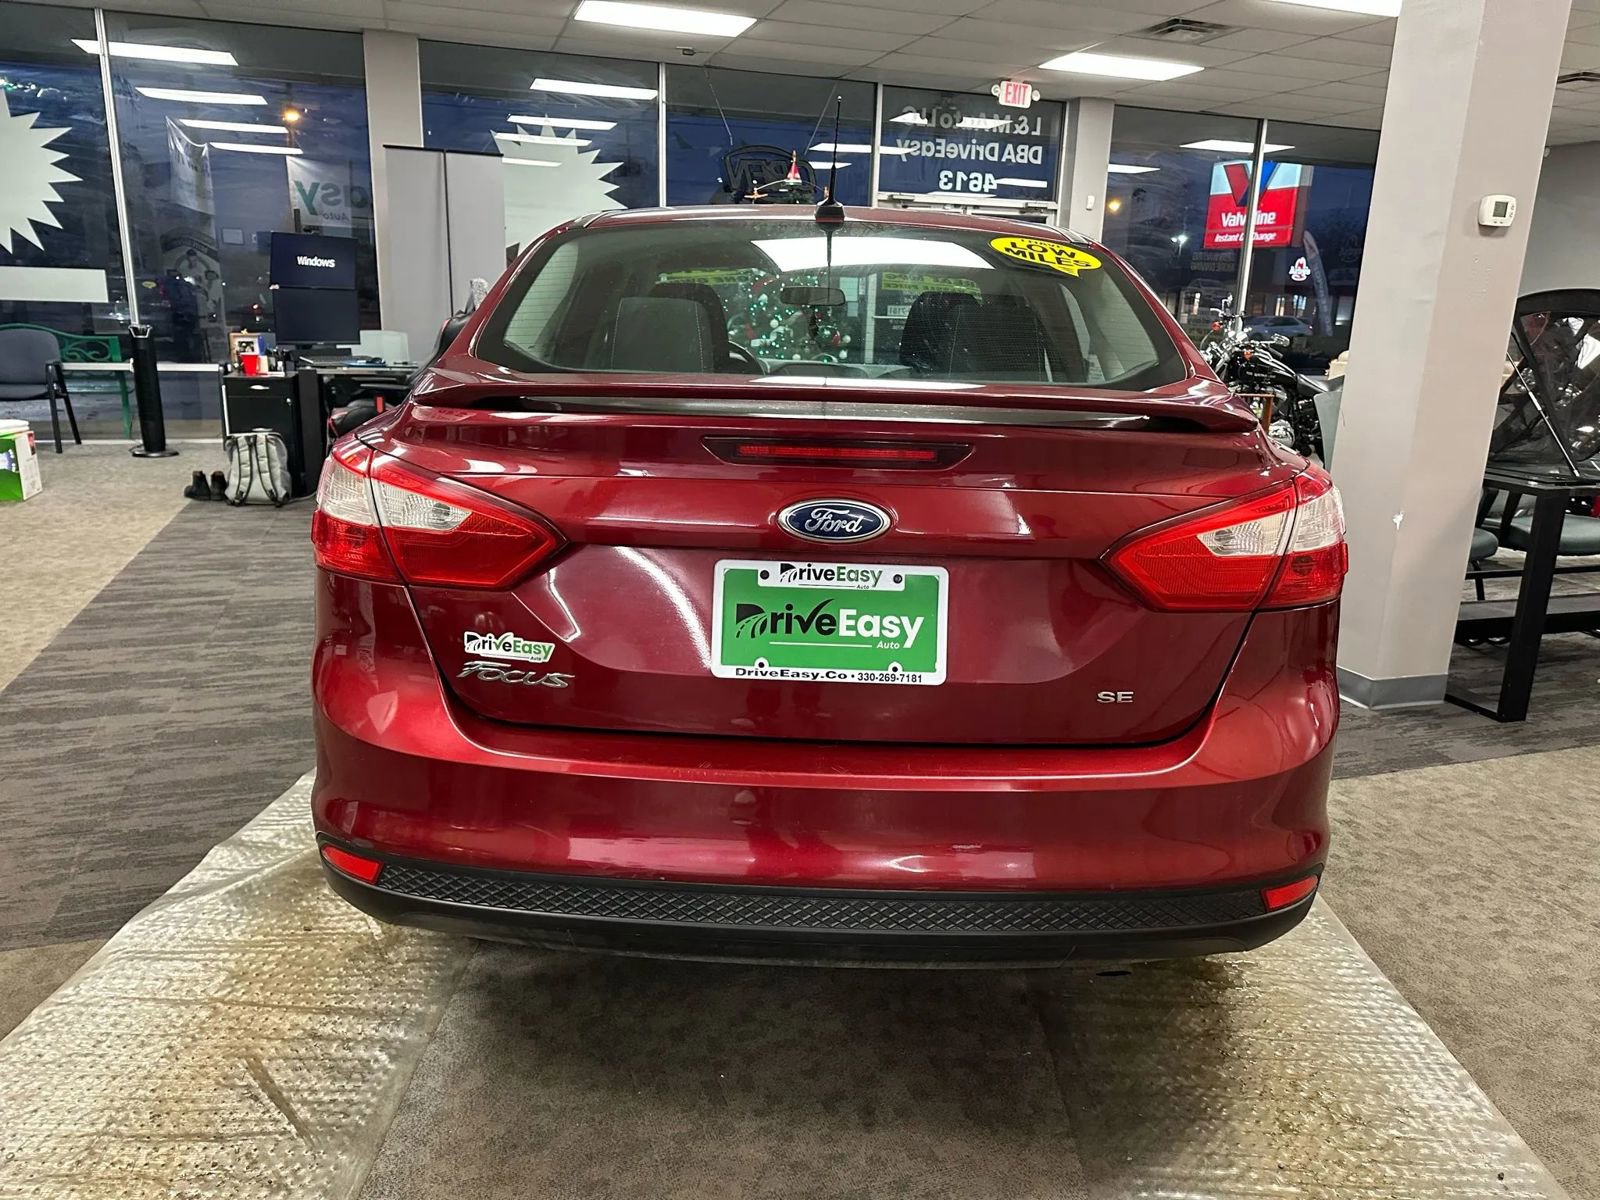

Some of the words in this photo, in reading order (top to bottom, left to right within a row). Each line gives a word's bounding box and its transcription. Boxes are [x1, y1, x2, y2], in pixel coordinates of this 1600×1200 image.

[1005, 82, 1028, 105] EXIT
[1221, 210, 1277, 228] Valvine
[1004, 247, 1092, 267] MILES
[1010, 241, 1076, 259] LOW
[297, 255, 336, 268] Windows
[804, 507, 863, 533] Ford
[779, 562, 883, 588] DriveEasy
[735, 598, 925, 649] DriveEasy
[466, 633, 553, 660] DriveEasy
[876, 640, 901, 650] Auto
[735, 667, 848, 681] DriveEasy.Co
[857, 672, 923, 684] 330-269-7181
[1096, 691, 1134, 704] SE
